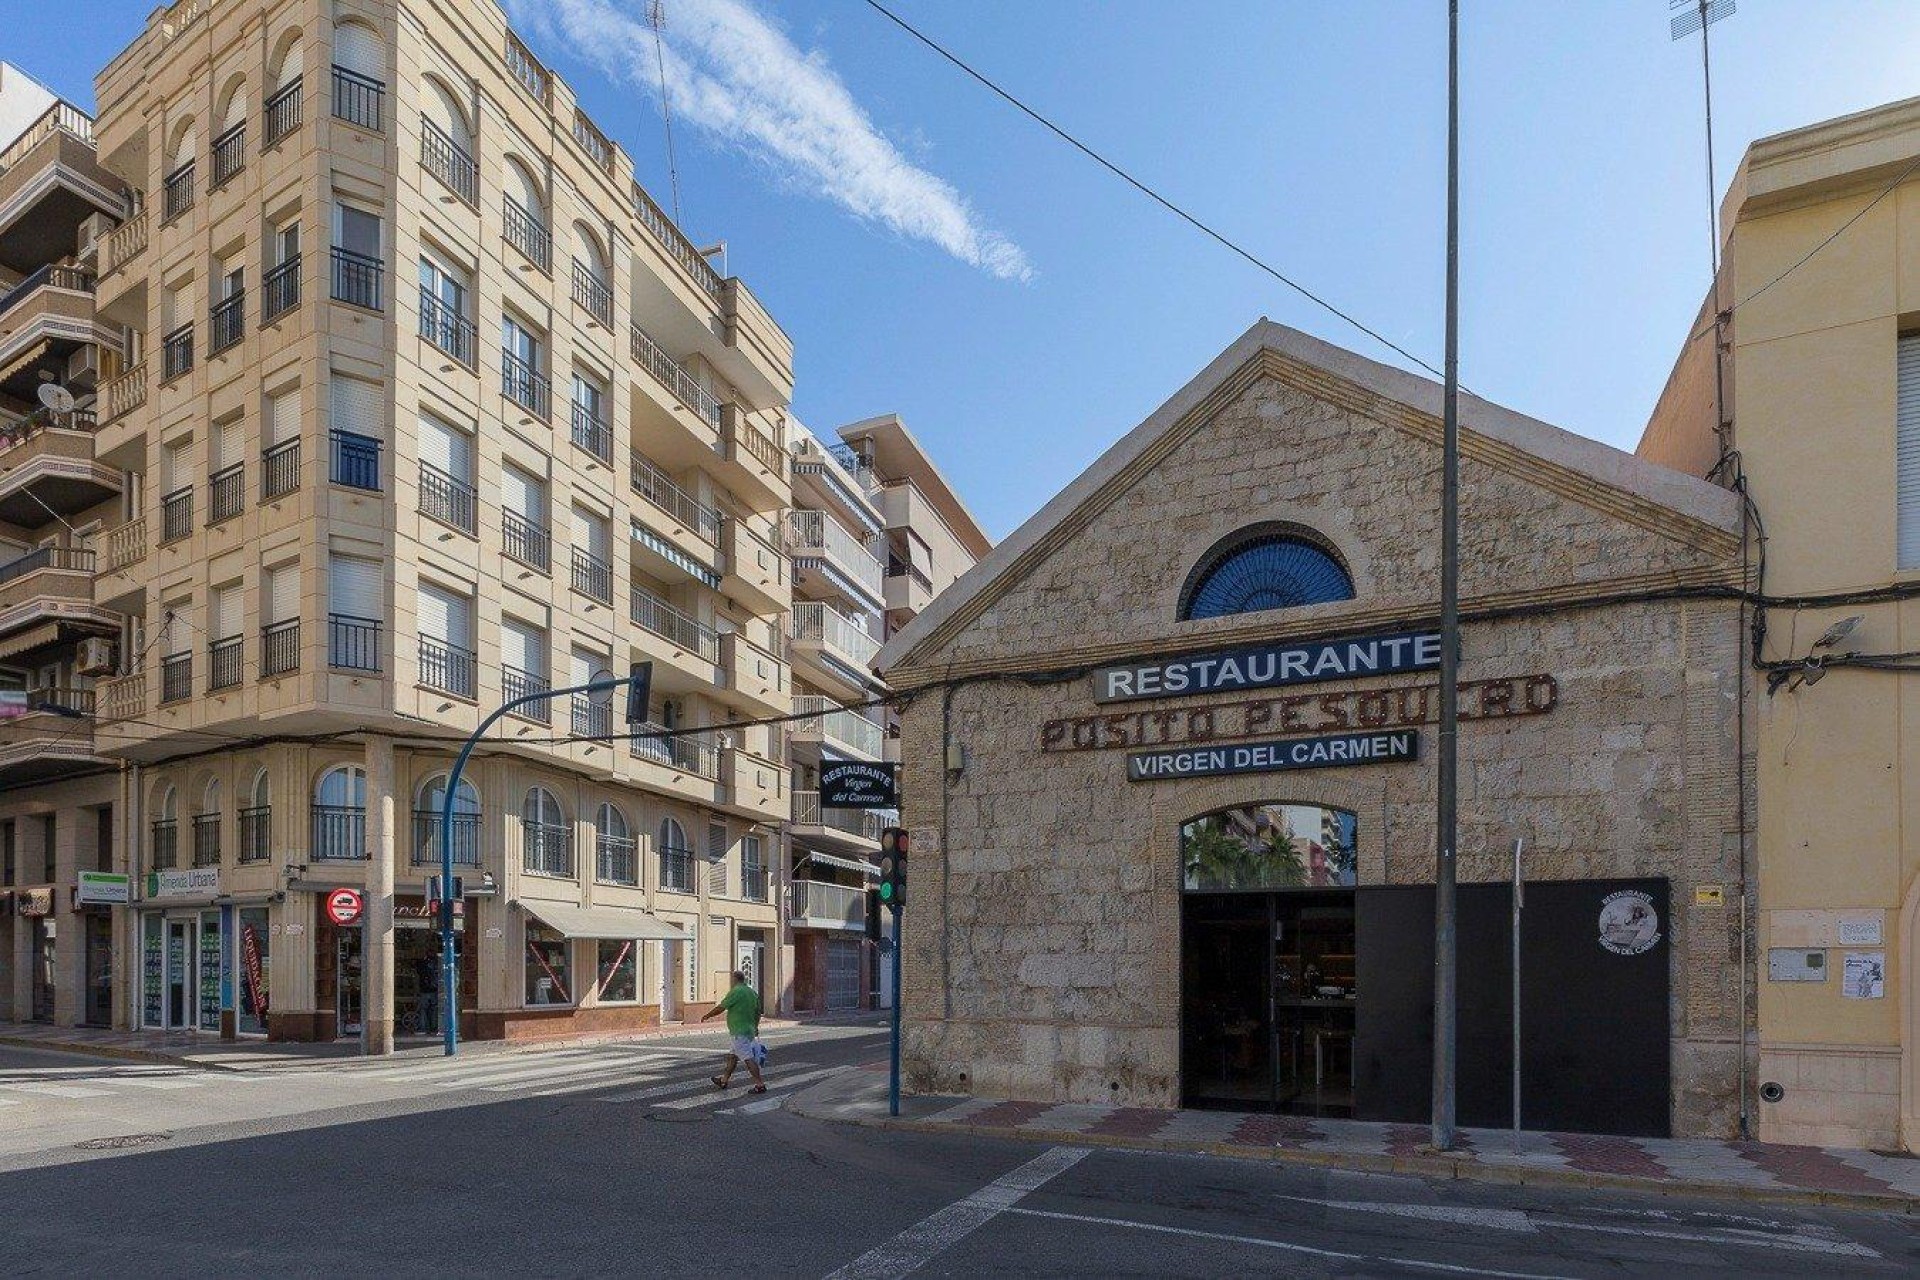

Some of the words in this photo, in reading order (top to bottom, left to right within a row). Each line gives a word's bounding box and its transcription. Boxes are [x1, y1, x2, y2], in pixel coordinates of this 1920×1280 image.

[1107, 633, 1442, 698] RESTAURANTE
[1041, 706, 1214, 754] POSITO
[1135, 750, 1226, 776] VIRGEN
[1234, 746, 1283, 768] DEL
[1291, 734, 1409, 763] CARMEN
[822, 765, 892, 787] RESTAURANTE
[844, 778, 873, 791] Virgen
[832, 793, 848, 802] del
[848, 793, 884, 803] Carmen
[188, 870, 216, 888] Urbana
